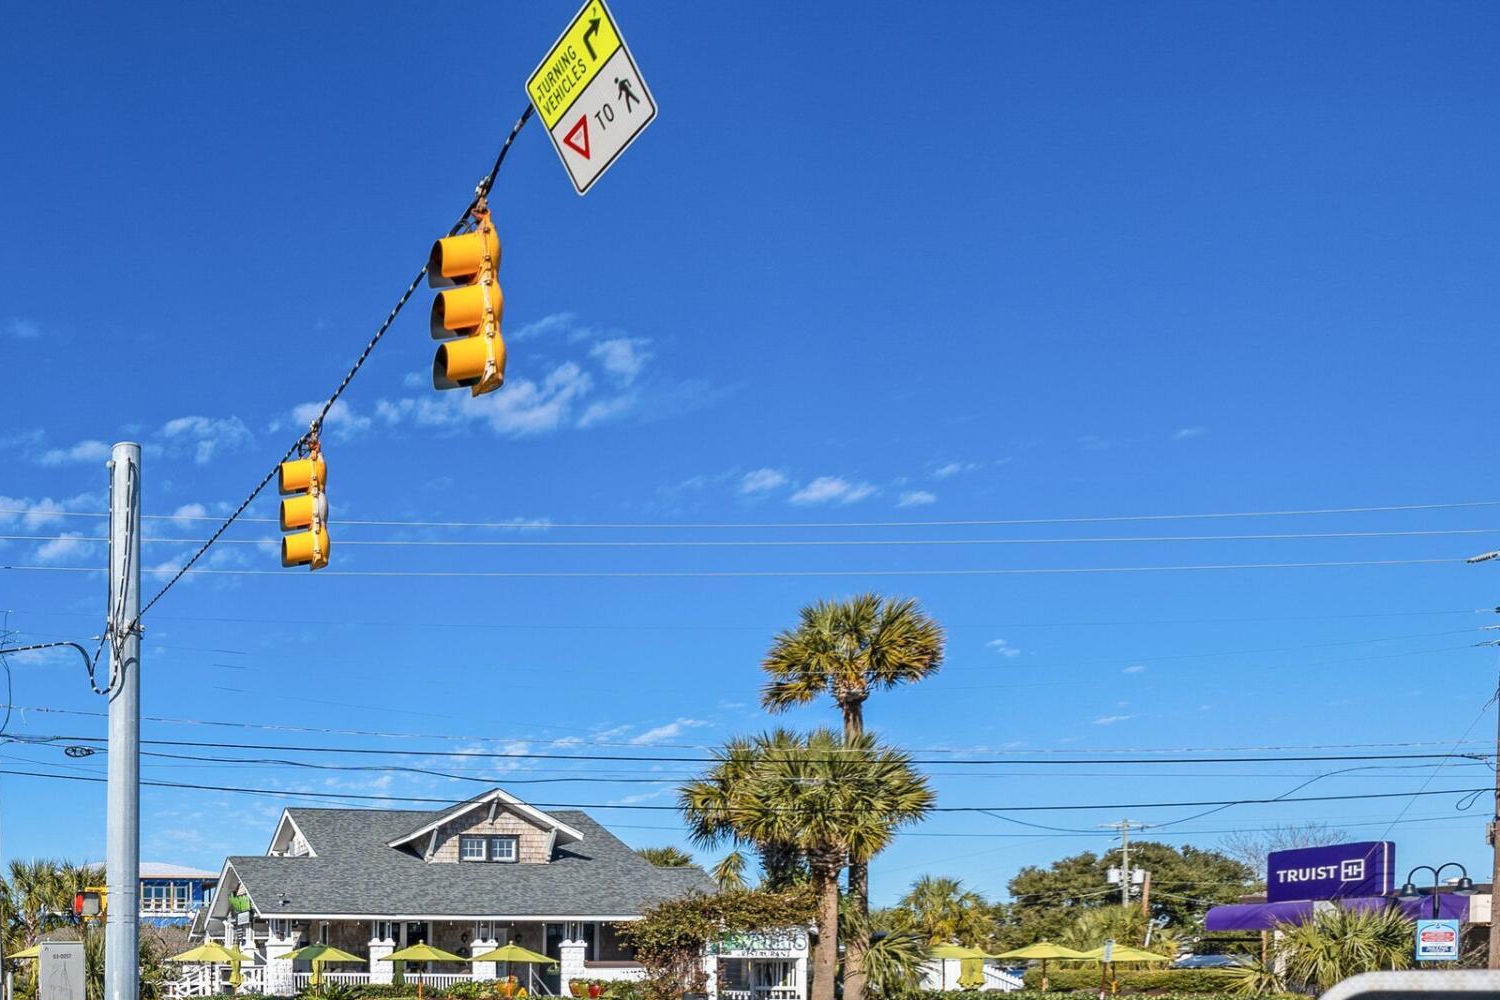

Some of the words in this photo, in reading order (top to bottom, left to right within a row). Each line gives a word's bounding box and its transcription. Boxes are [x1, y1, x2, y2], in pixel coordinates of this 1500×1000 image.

[536, 45, 577, 99] TURNING
[542, 58, 587, 116] VEHICLES
[594, 103, 615, 131] TO
[1276, 865, 1339, 884] TRUIST
